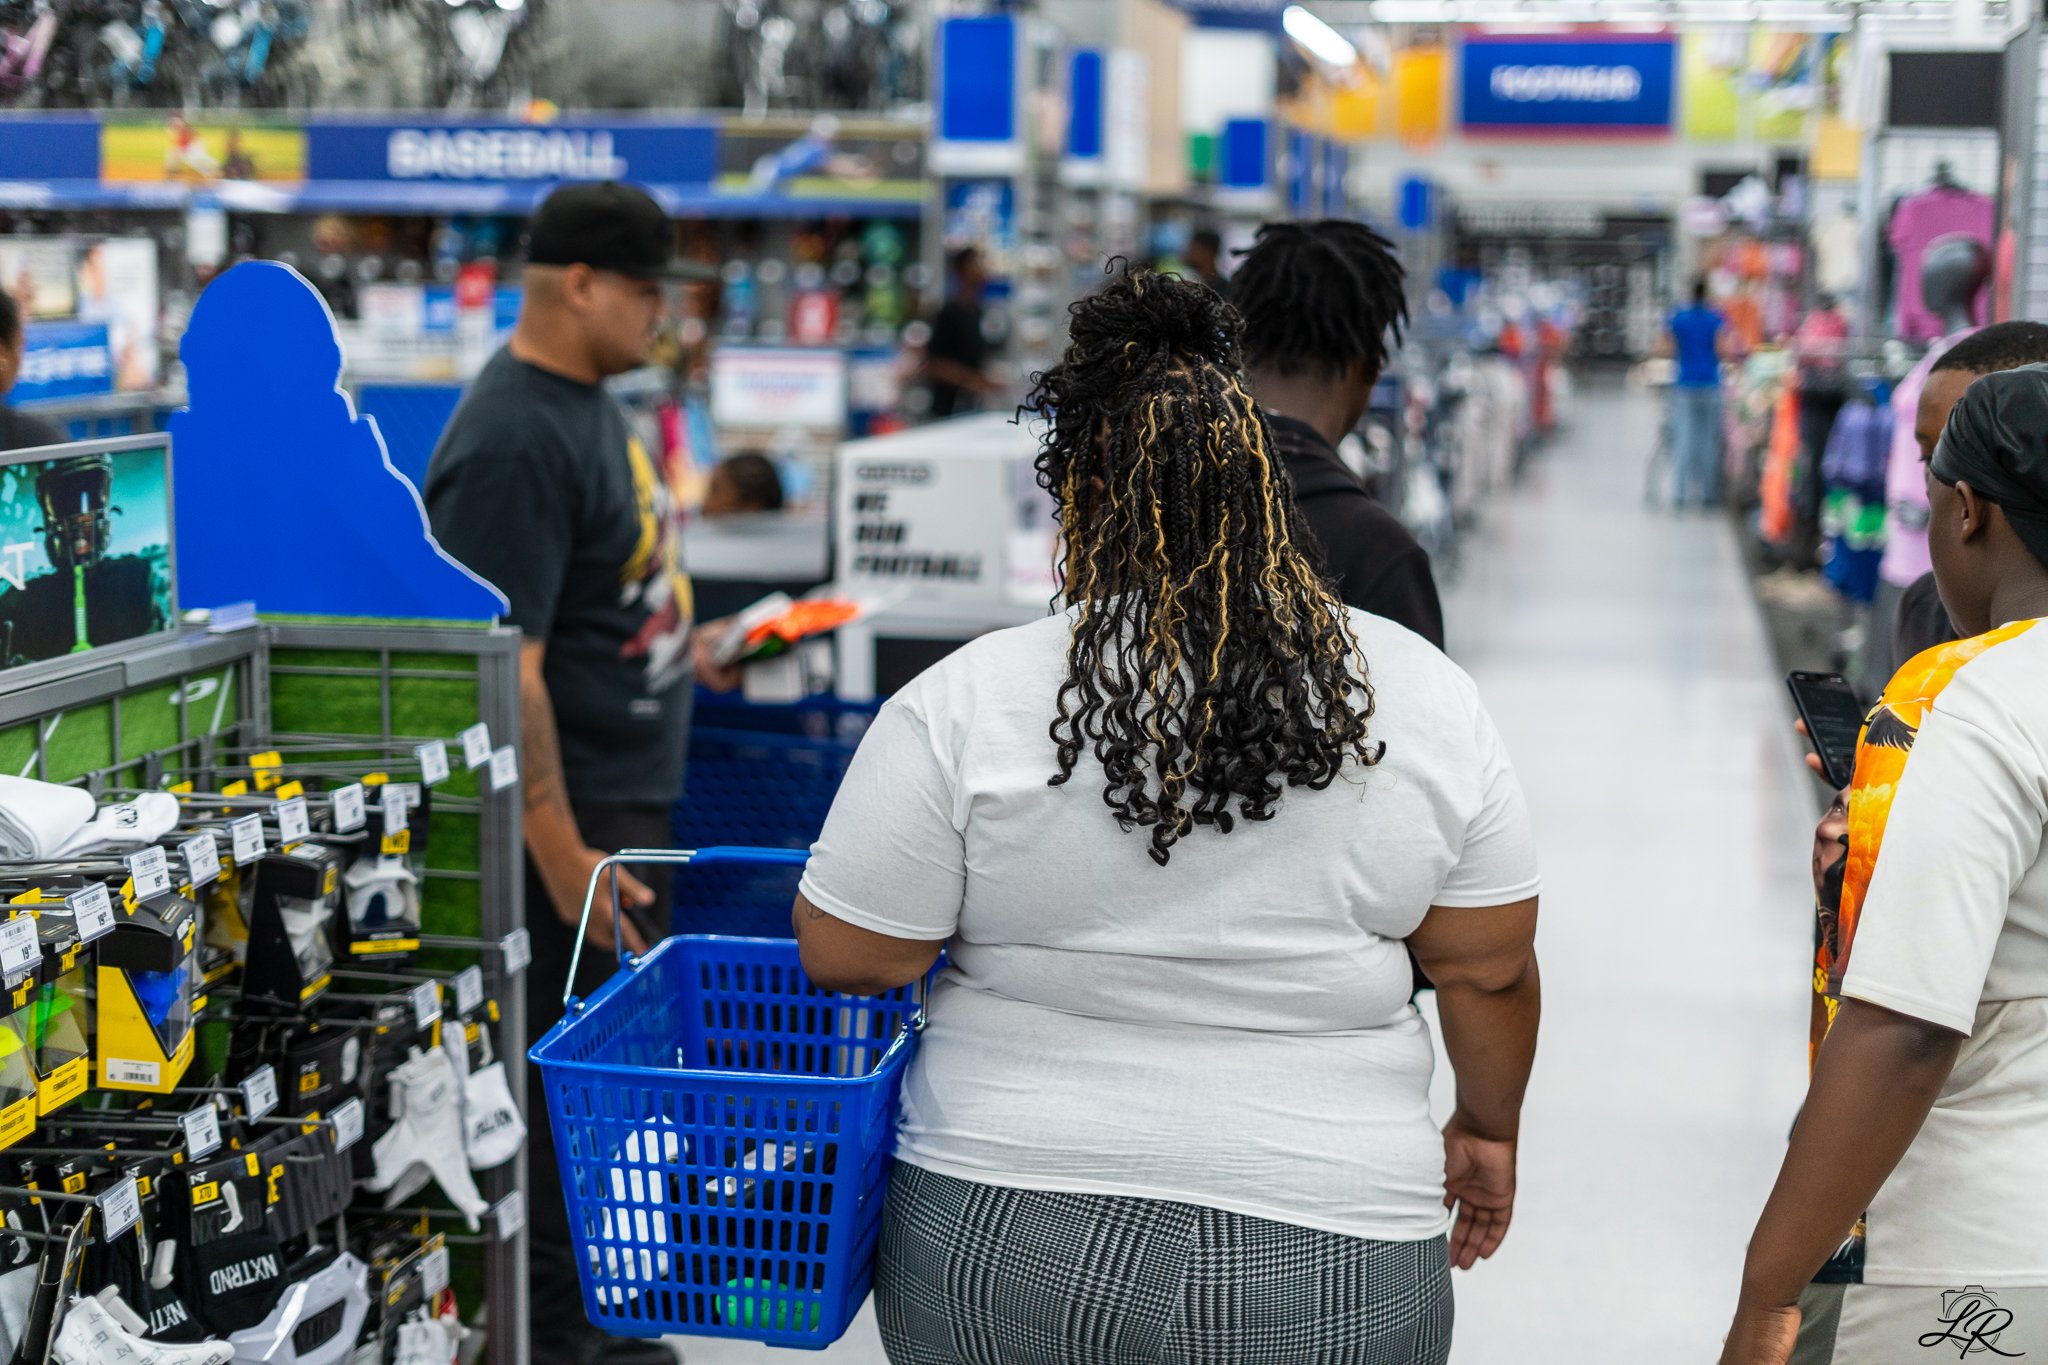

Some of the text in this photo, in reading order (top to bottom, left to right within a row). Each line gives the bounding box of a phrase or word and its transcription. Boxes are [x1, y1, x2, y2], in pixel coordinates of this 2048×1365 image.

[389, 131, 623, 177] BASEBALL
[853, 553, 981, 579] FOOTBALL
[209, 1253, 279, 1295] NXTRND
